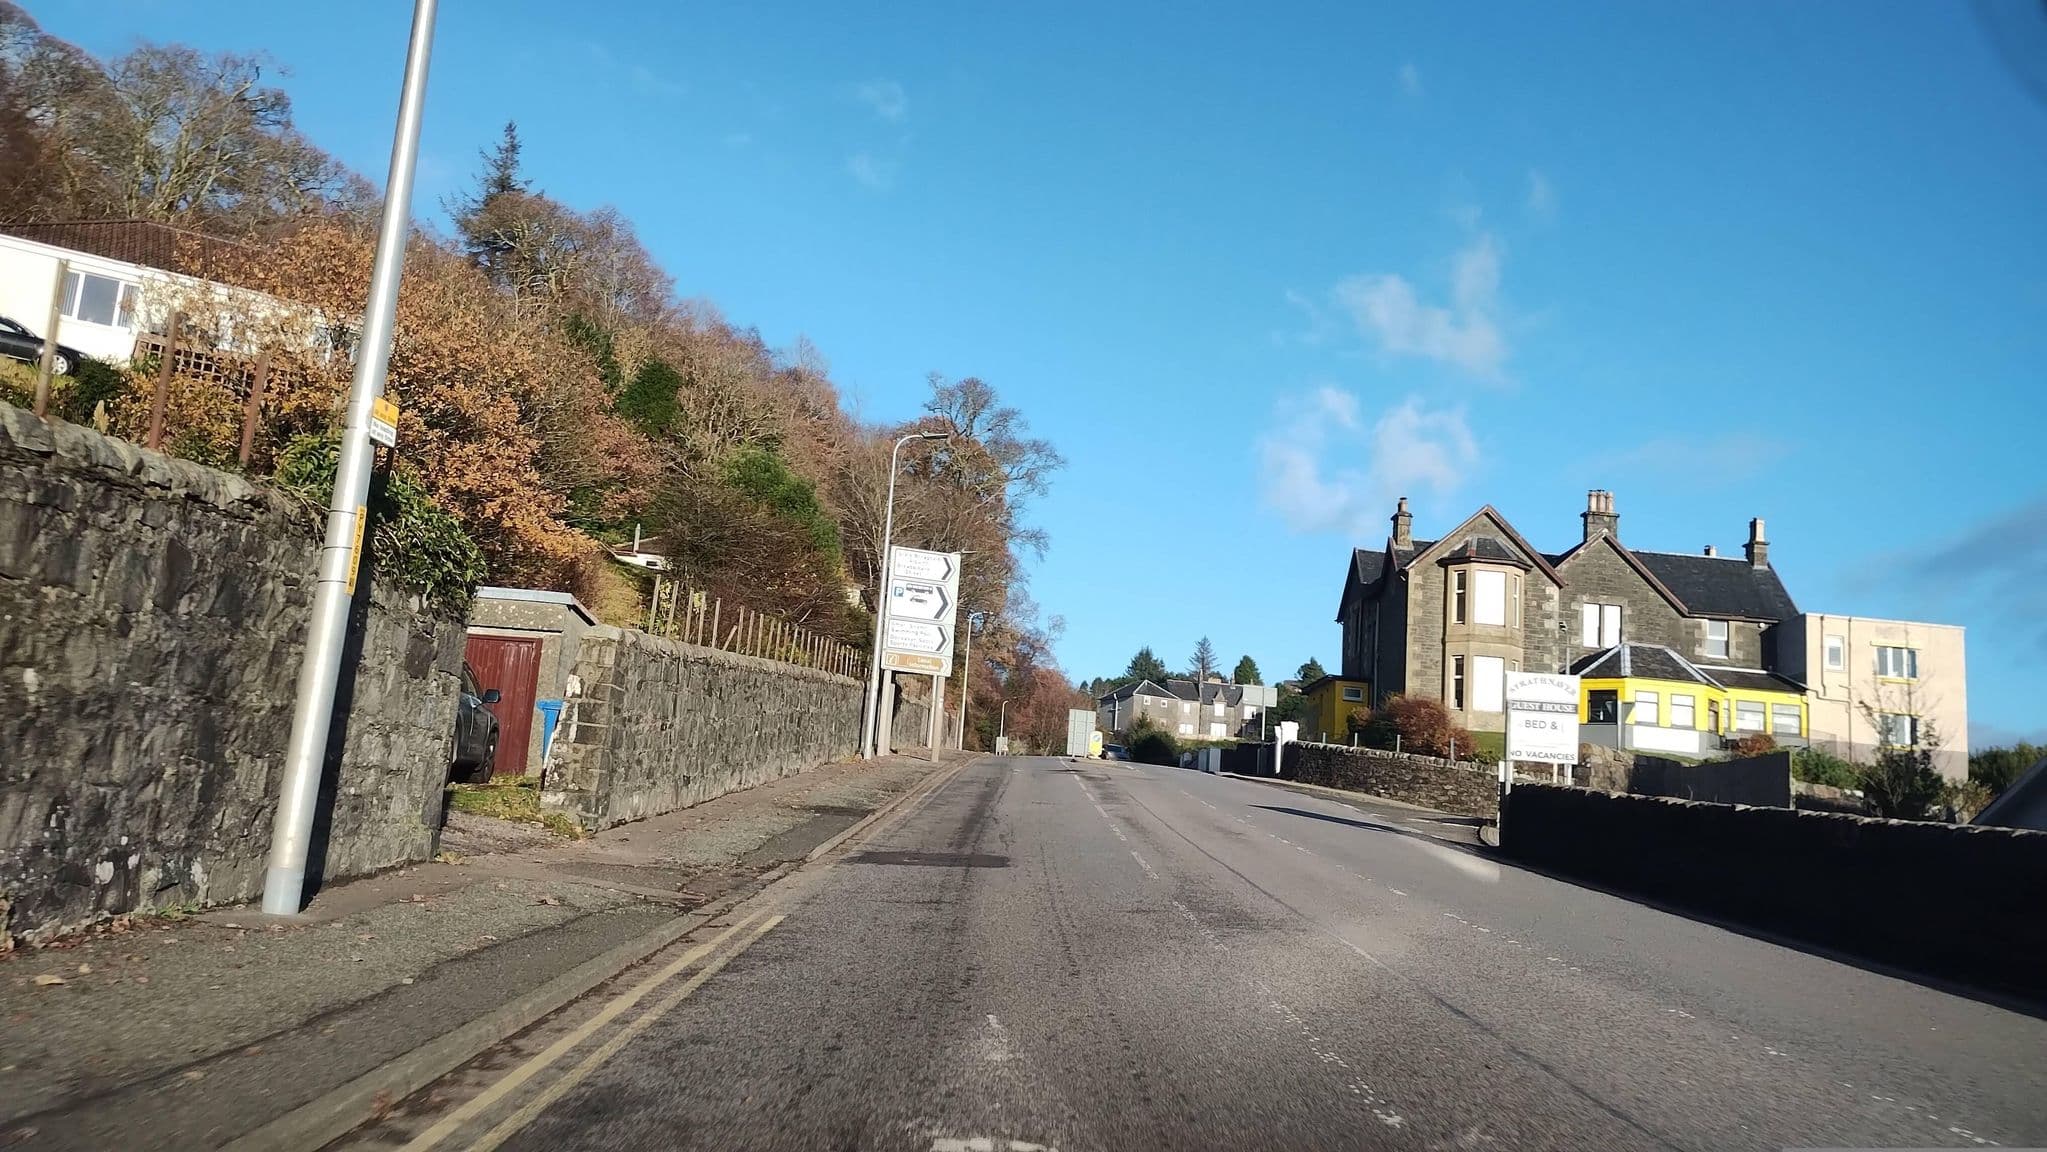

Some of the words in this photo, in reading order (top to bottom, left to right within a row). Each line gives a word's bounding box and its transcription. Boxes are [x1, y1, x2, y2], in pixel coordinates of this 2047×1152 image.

[1542, 704, 1576, 713] HOUSE
[1524, 719, 1546, 729] BED
[1550, 721, 1558, 730] &
[1526, 750, 1575, 761] VACANCIES
